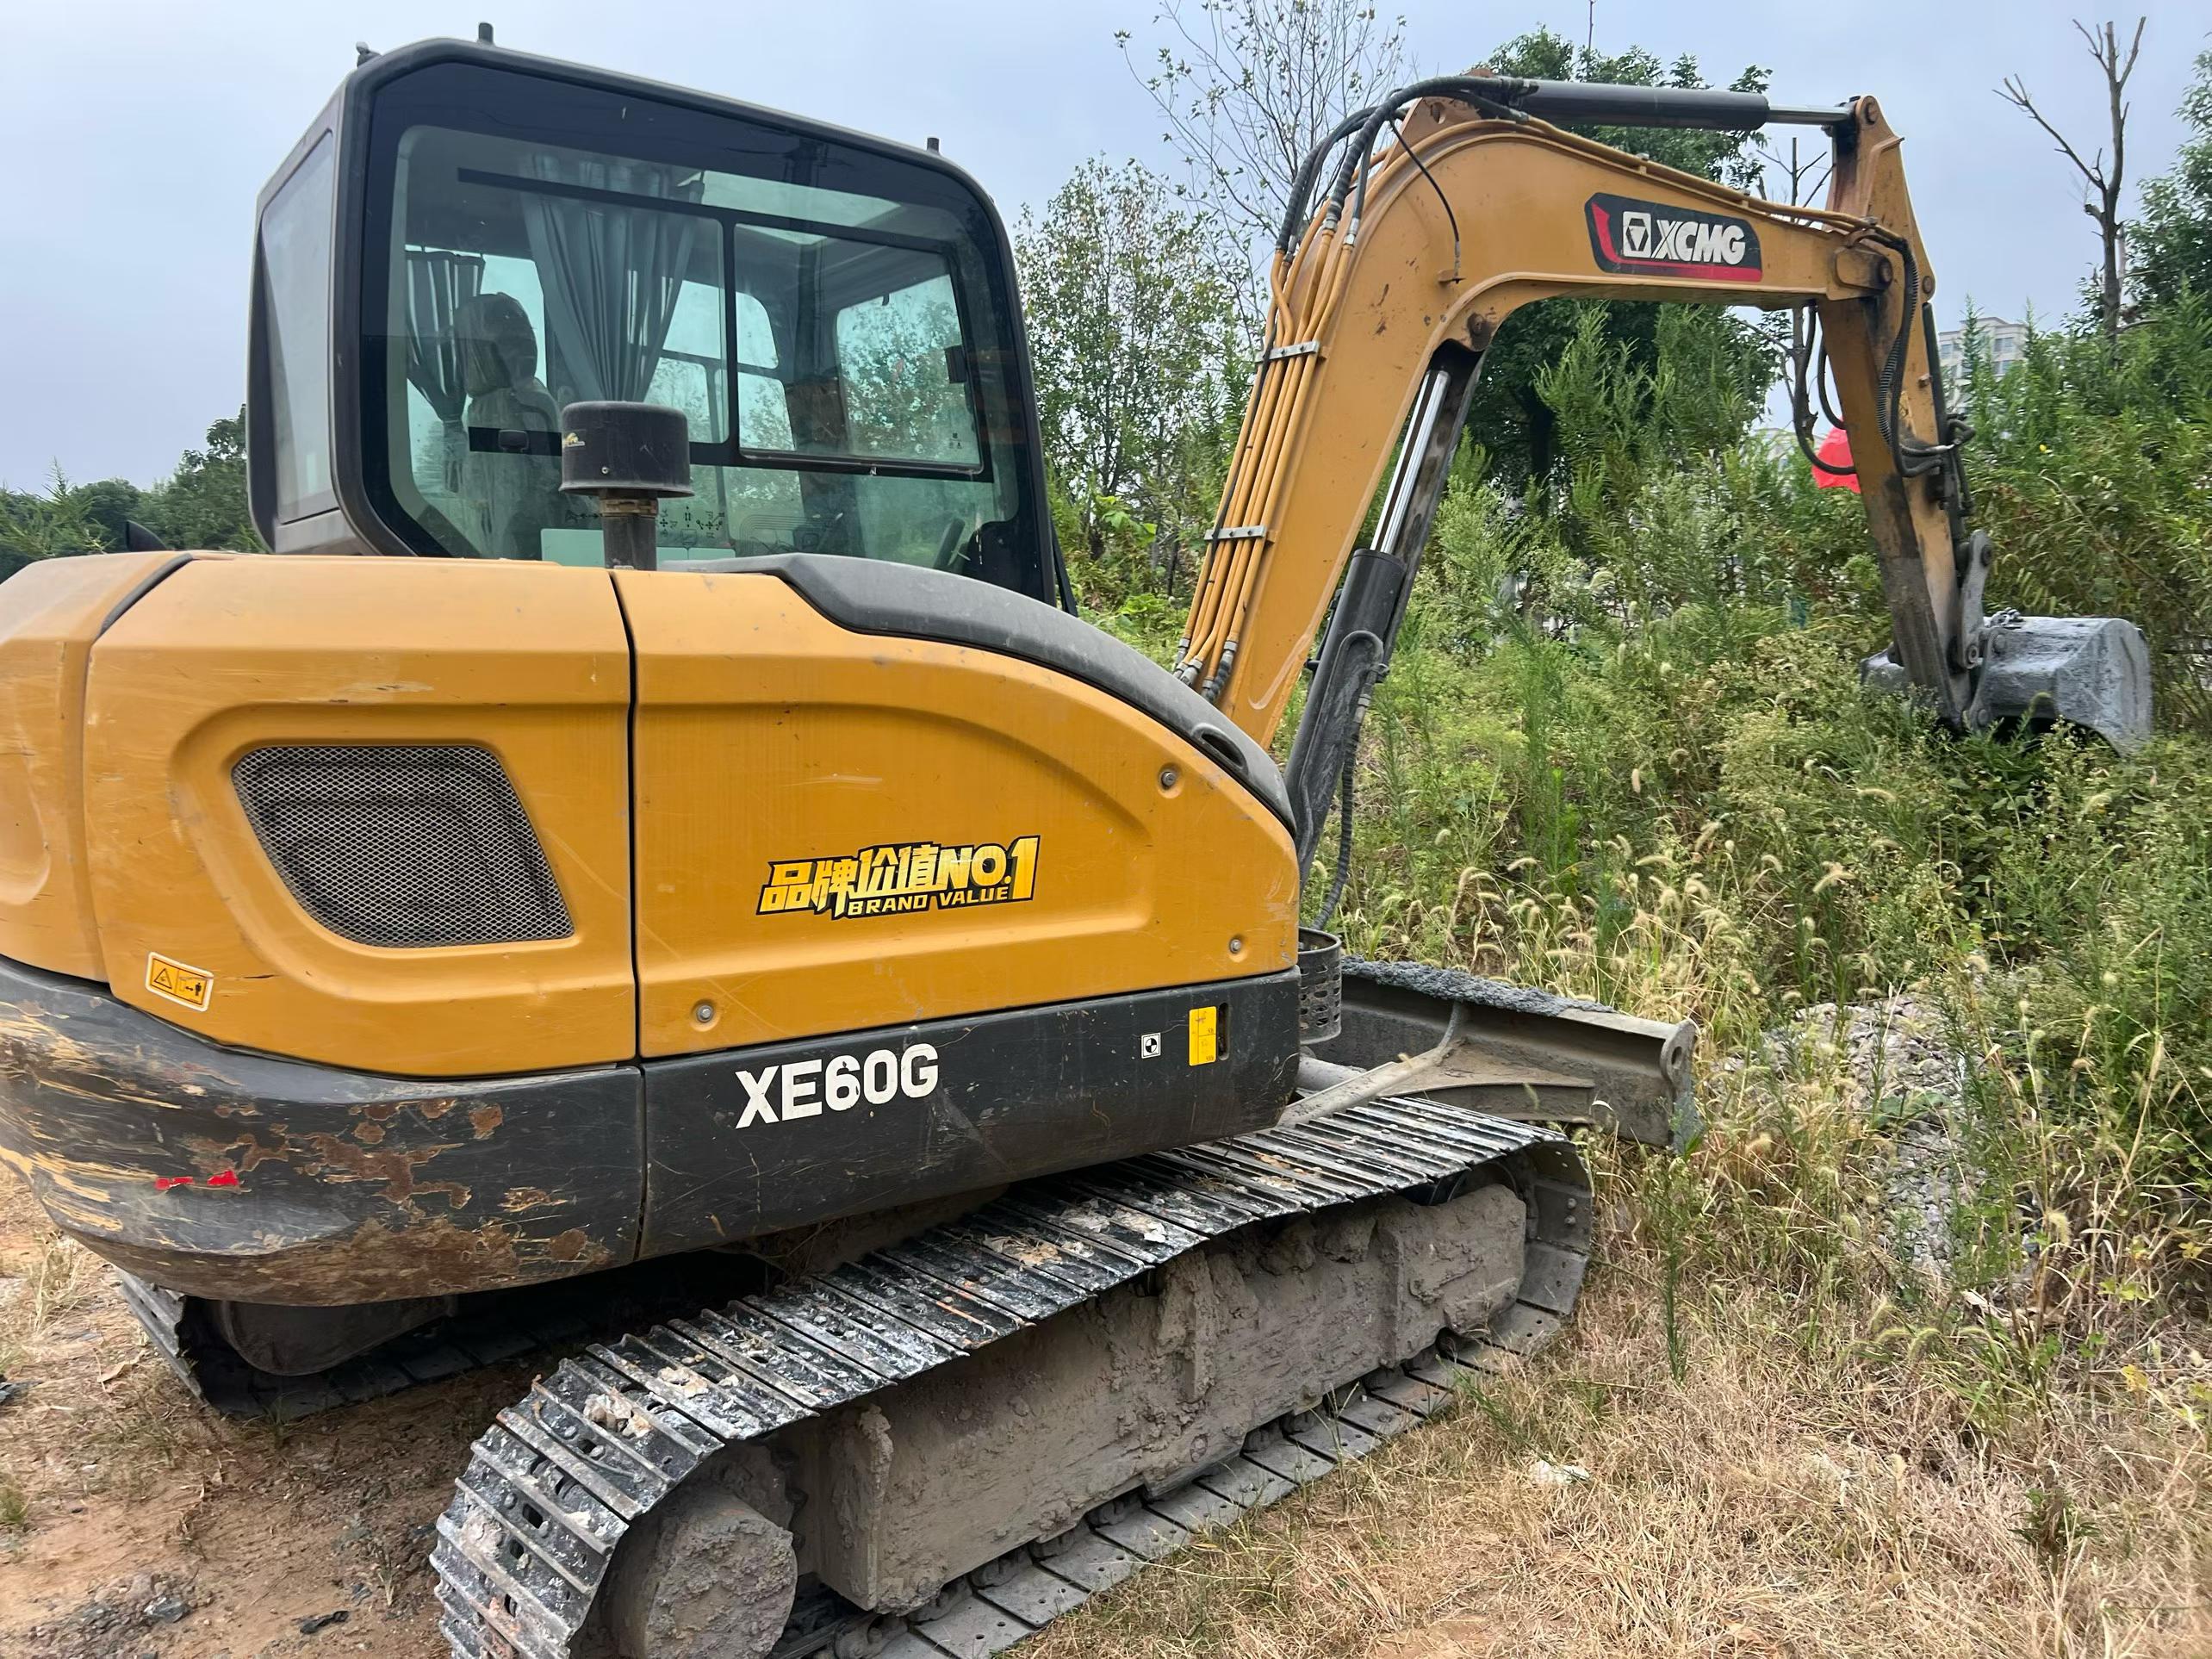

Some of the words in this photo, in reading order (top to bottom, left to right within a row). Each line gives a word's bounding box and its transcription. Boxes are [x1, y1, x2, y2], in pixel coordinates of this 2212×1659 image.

[1651, 220, 1745, 264] XCMG
[848, 895, 928, 916] BRAND
[940, 886, 1009, 906] VALUE
[735, 1043, 939, 1129] XE60G
